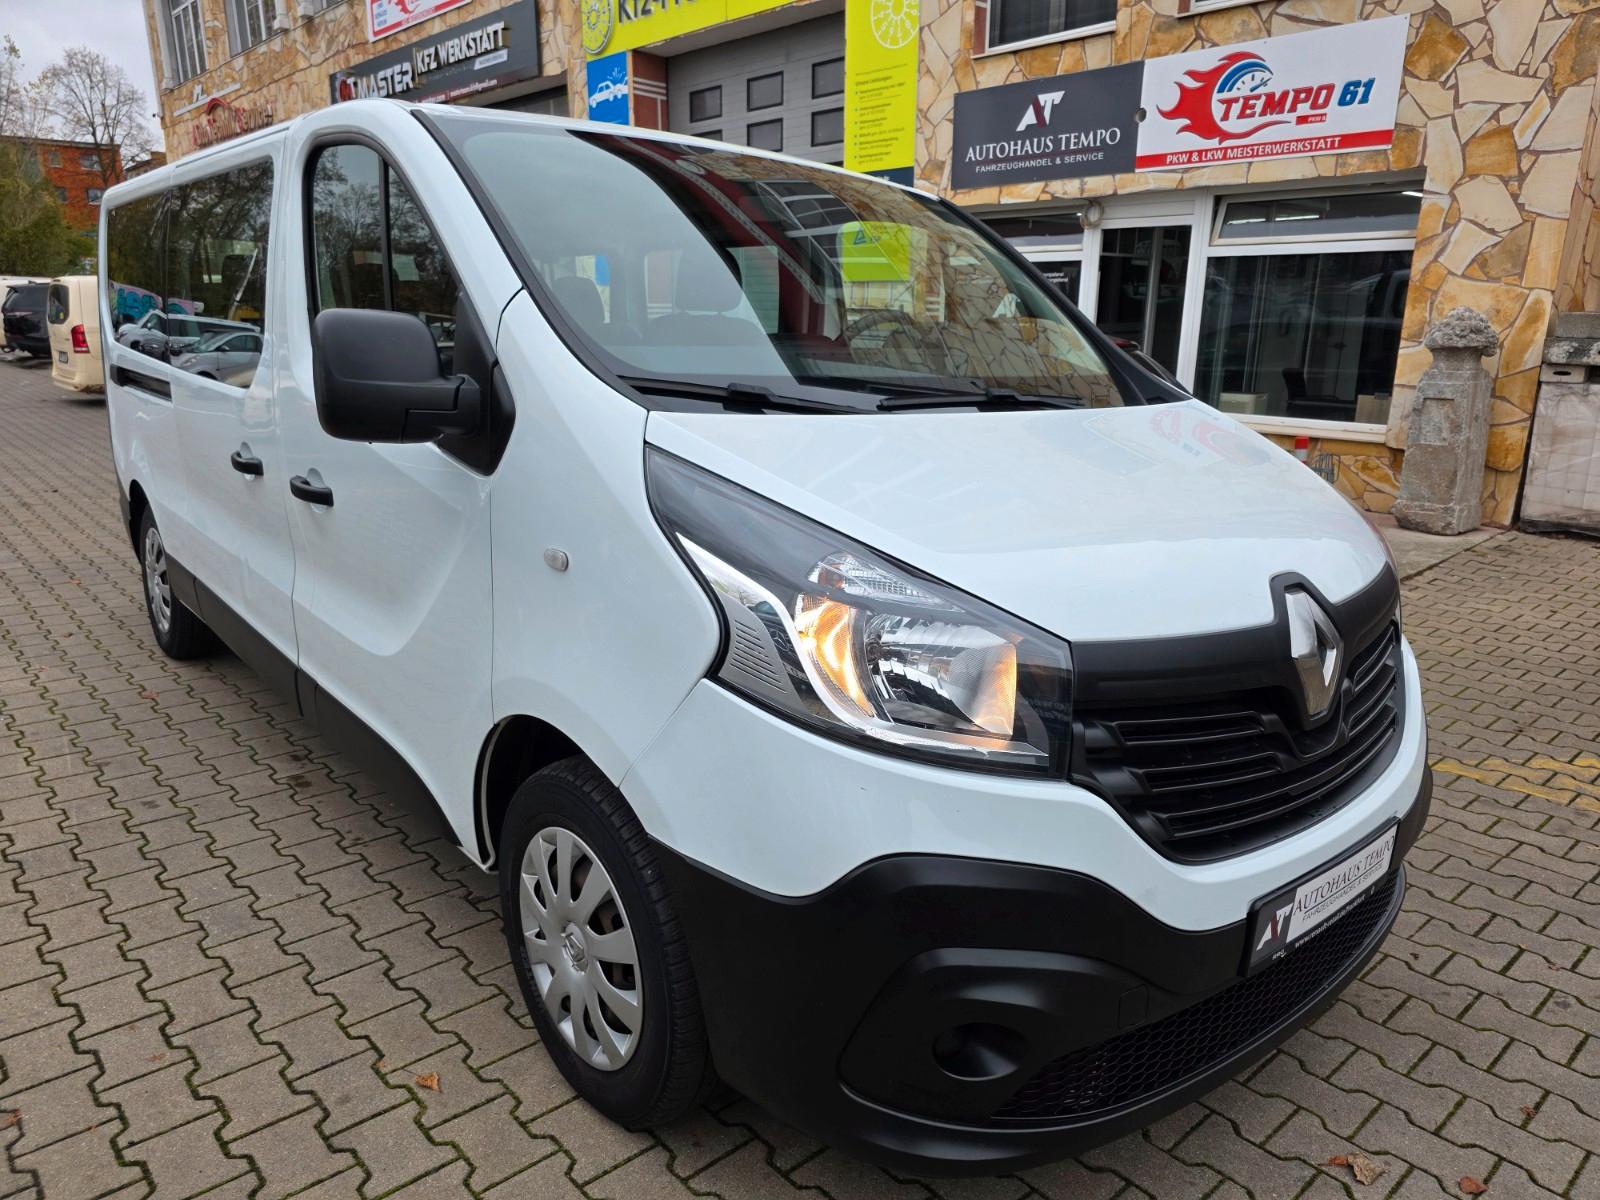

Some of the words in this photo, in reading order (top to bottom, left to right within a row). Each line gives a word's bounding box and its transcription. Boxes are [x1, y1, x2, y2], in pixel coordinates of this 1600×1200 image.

[416, 49, 438, 75] KFZ
[437, 21, 506, 65] WERKSTATT
[1217, 83, 1336, 122] TEMPO
[1337, 77, 1376, 107] 61
[965, 135, 1054, 162] AUTOHAUS
[1058, 127, 1121, 151] TEMPO
[975, 157, 1053, 174] FAHRZEUGHANDEL
[1055, 156, 1062, 166] &
[1063, 151, 1104, 165] SERVICE
[1166, 152, 1189, 165] PKW
[1191, 151, 1200, 163] &
[1201, 148, 1224, 161] LKW
[1226, 137, 1341, 159] MEISTERWERKSTATT
[1293, 859, 1362, 916] AUTOHAUS
